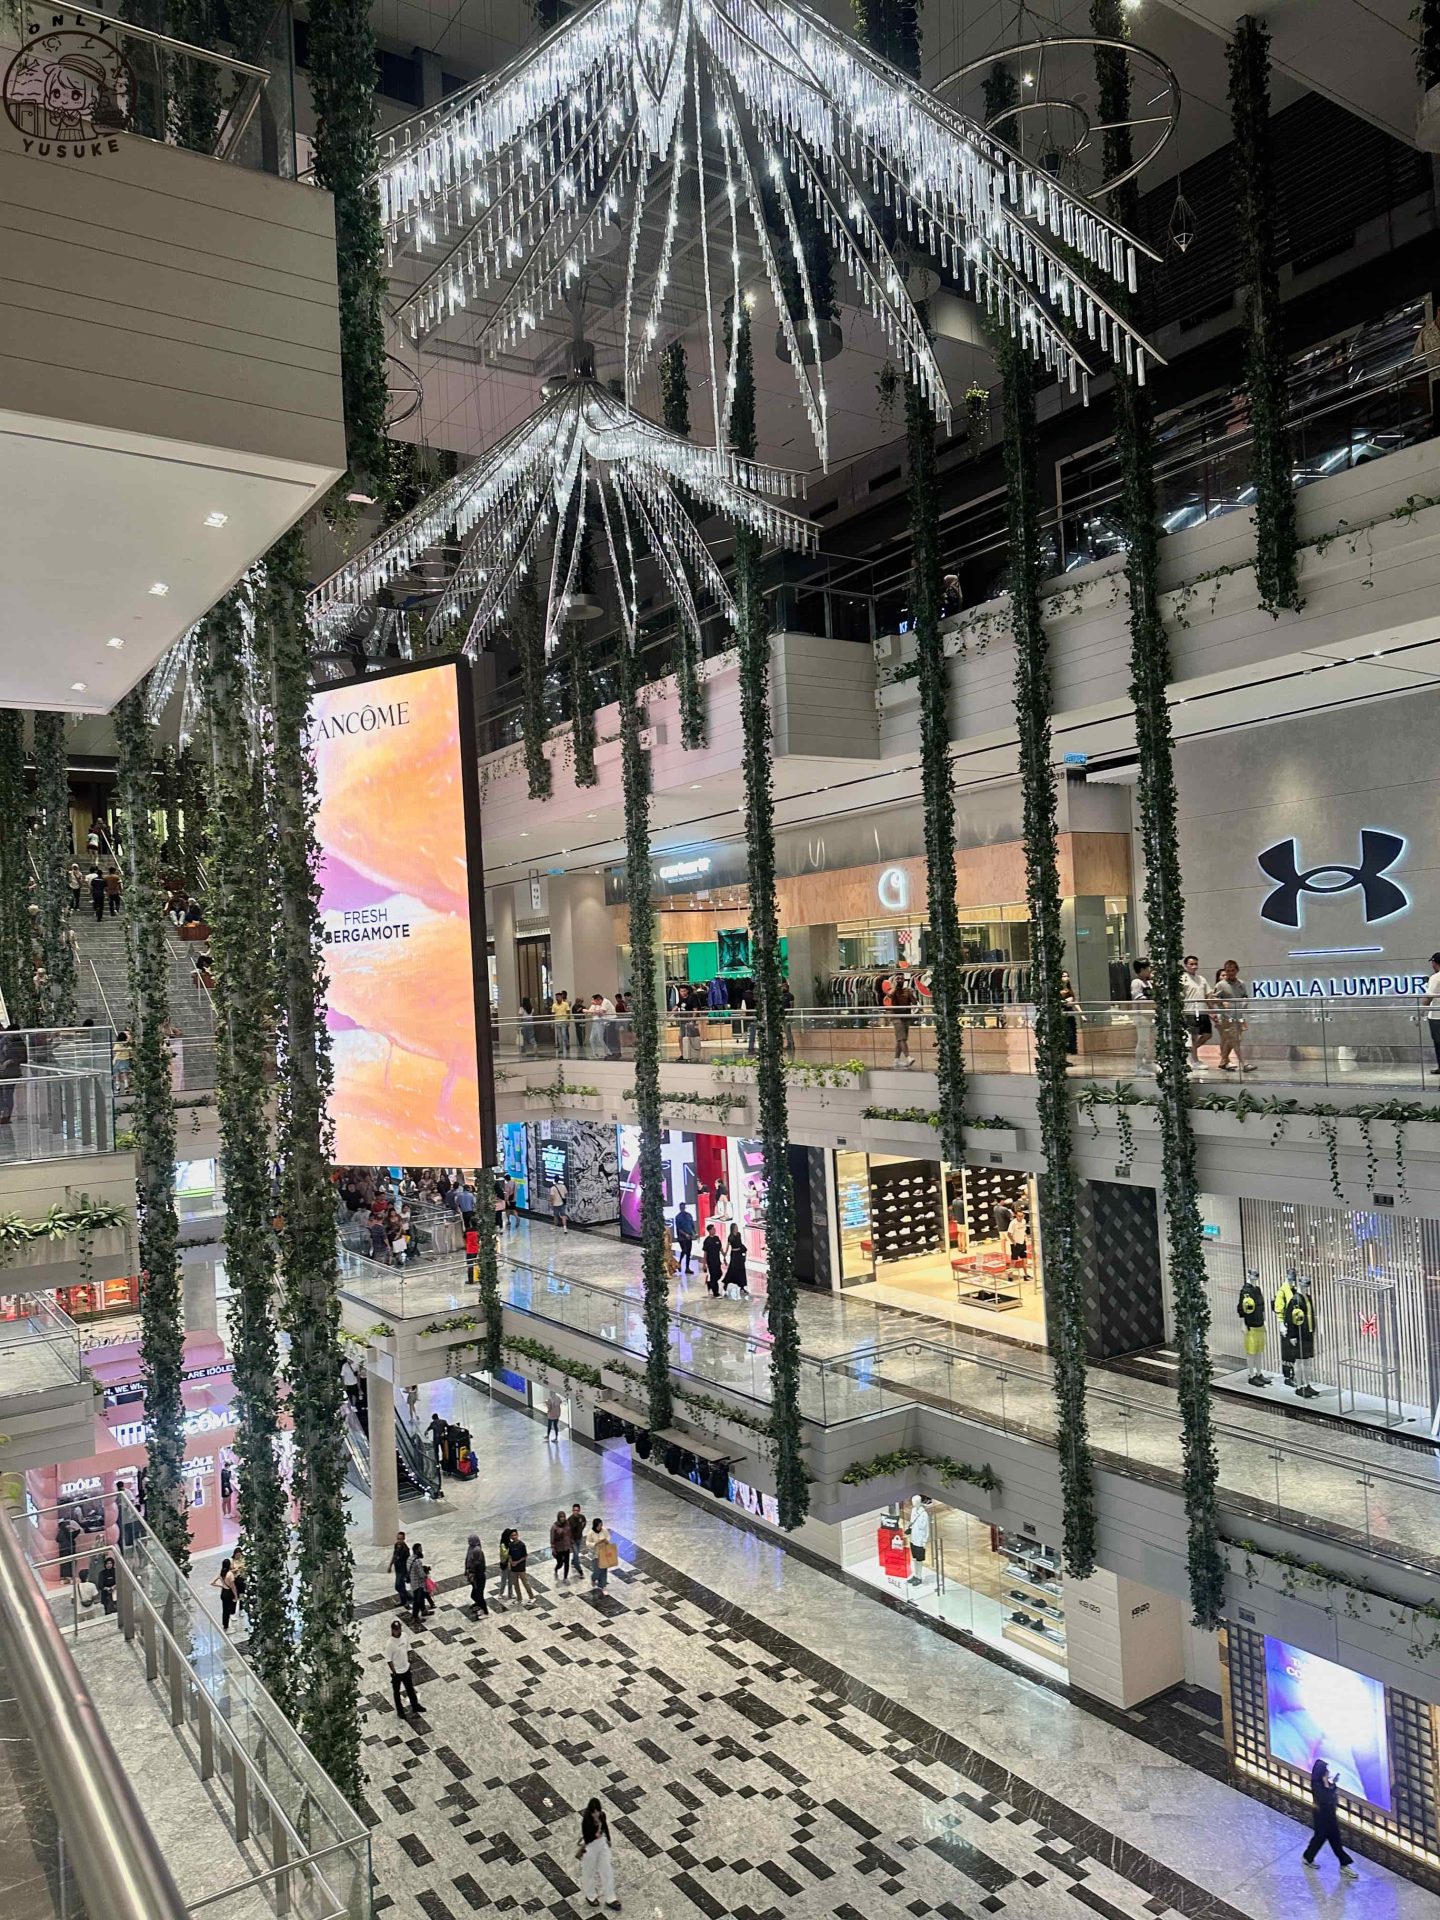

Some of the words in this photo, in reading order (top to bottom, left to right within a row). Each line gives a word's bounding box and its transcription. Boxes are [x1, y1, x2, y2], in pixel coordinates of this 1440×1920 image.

[344, 908, 388, 927] FRESH
[325, 923, 411, 945] BERGAMOTE
[1252, 979, 1324, 998] KUALA
[1330, 975, 1428, 997] LUMPUR
[115, 1384, 129, 1394] WE
[187, 1369, 206, 1380] ARE
[61, 1476, 102, 1494] IDÔLE
